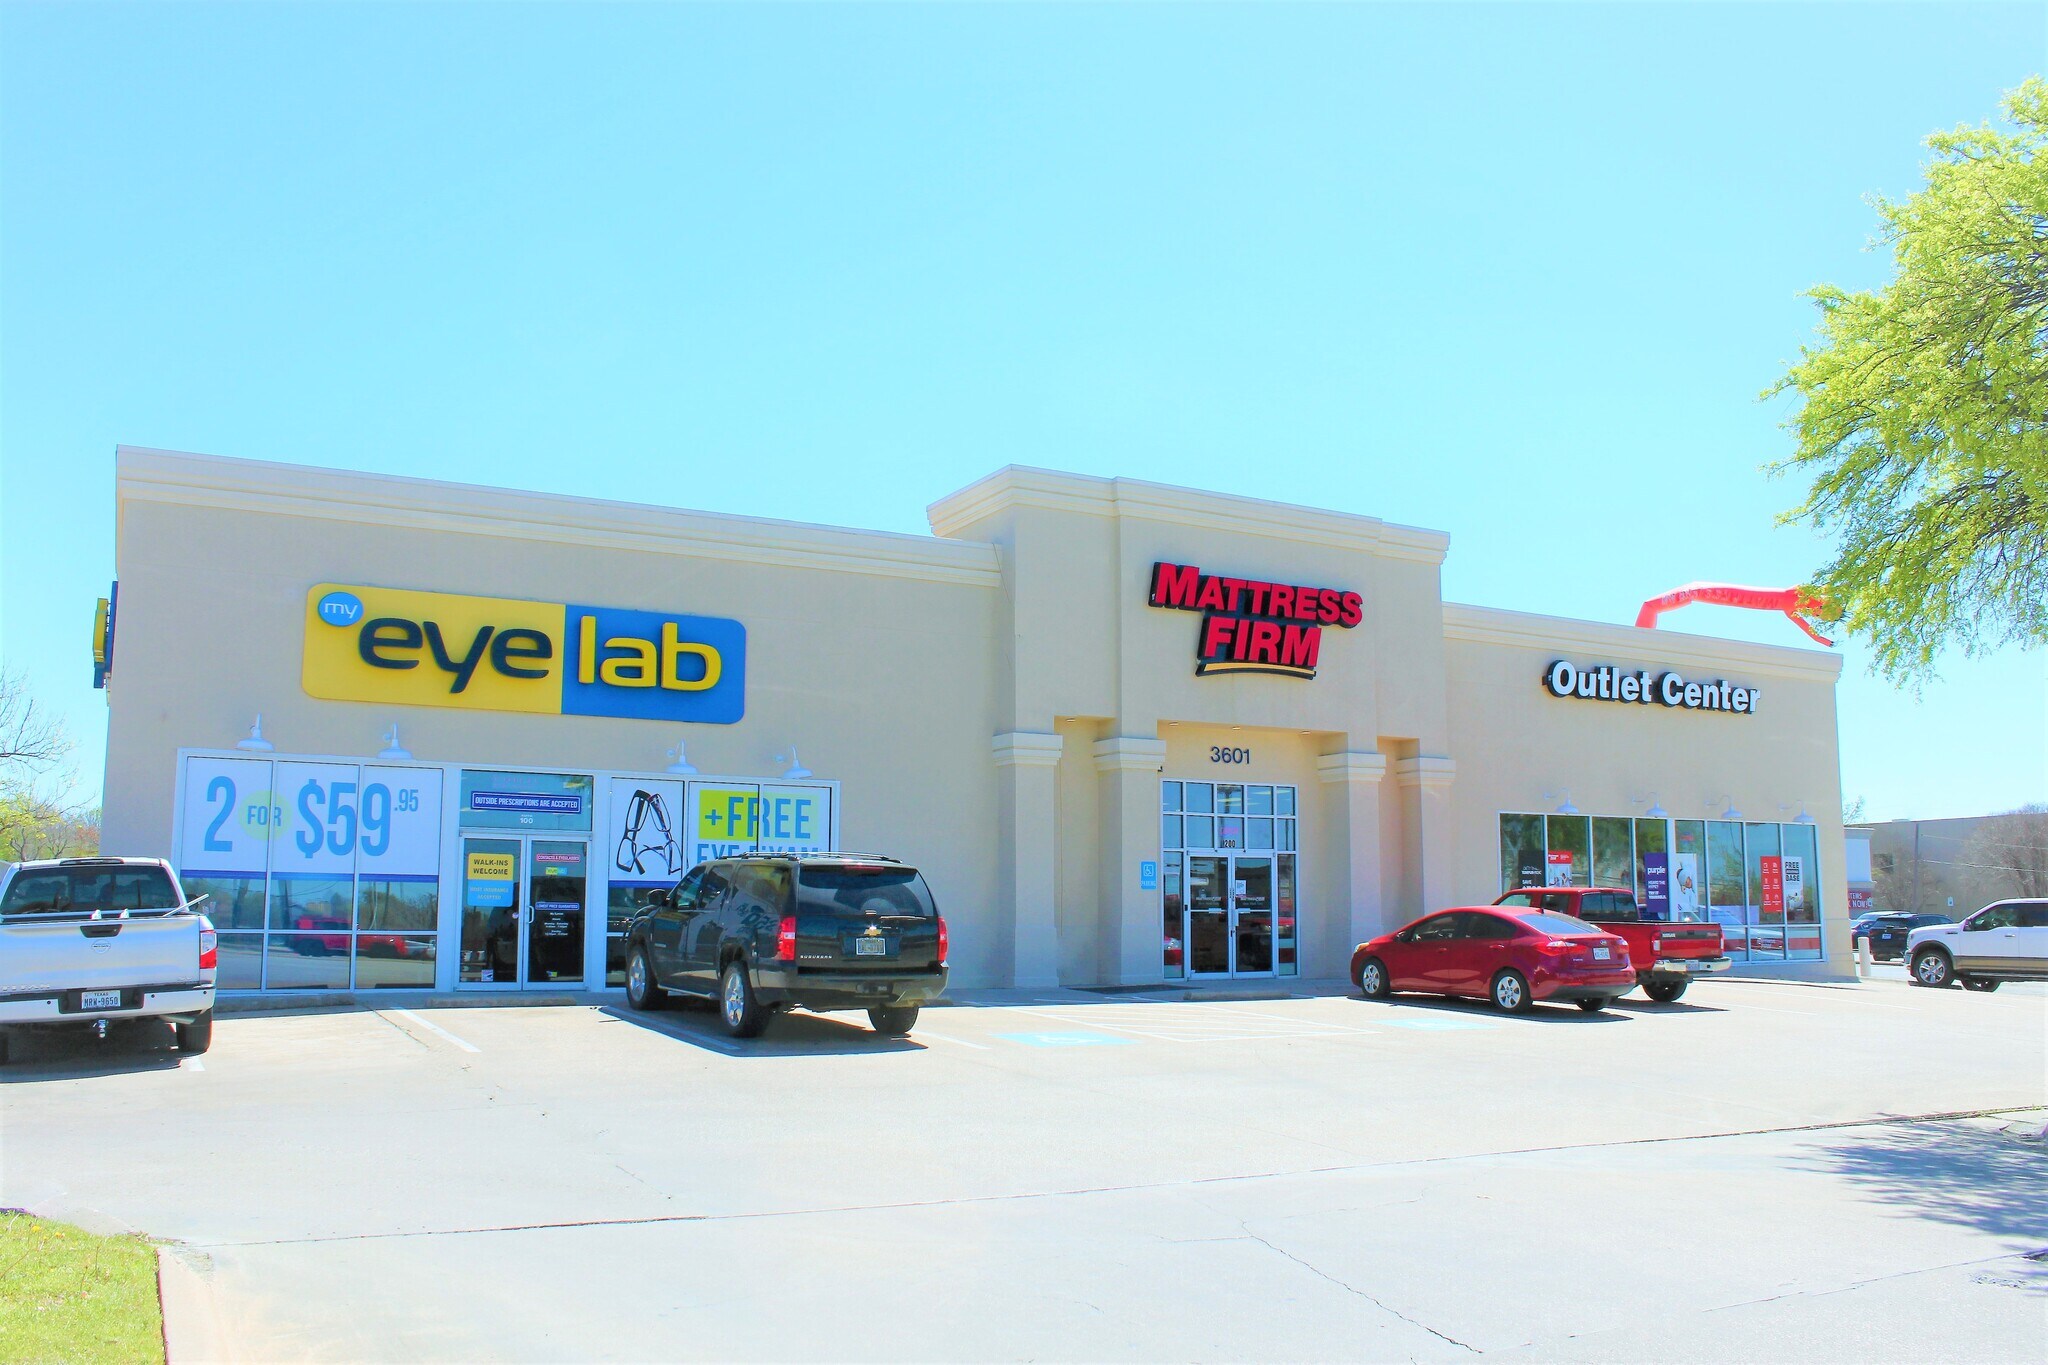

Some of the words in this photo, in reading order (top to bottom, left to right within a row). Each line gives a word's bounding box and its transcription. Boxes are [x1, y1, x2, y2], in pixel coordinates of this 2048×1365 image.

[1151, 562, 1363, 628] MATTRESS
[324, 601, 358, 620] my
[1203, 615, 1322, 668] FIRM
[1549, 659, 1653, 704] Outlet
[1659, 671, 1761, 714] Center
[1210, 746, 1250, 765] 3601
[475, 796, 498, 805] OUTSIDE
[498, 797, 539, 807] PRESCRIPTIONS
[540, 799, 550, 808] ARE
[551, 800, 578, 809] ACCEPTED
[203, 775, 237, 853] 2
[247, 804, 282, 828] FOR
[473, 859, 509, 867] WALK-INS
[1647, 865, 1666, 875] purple
[1785, 861, 1799, 869] FREE
